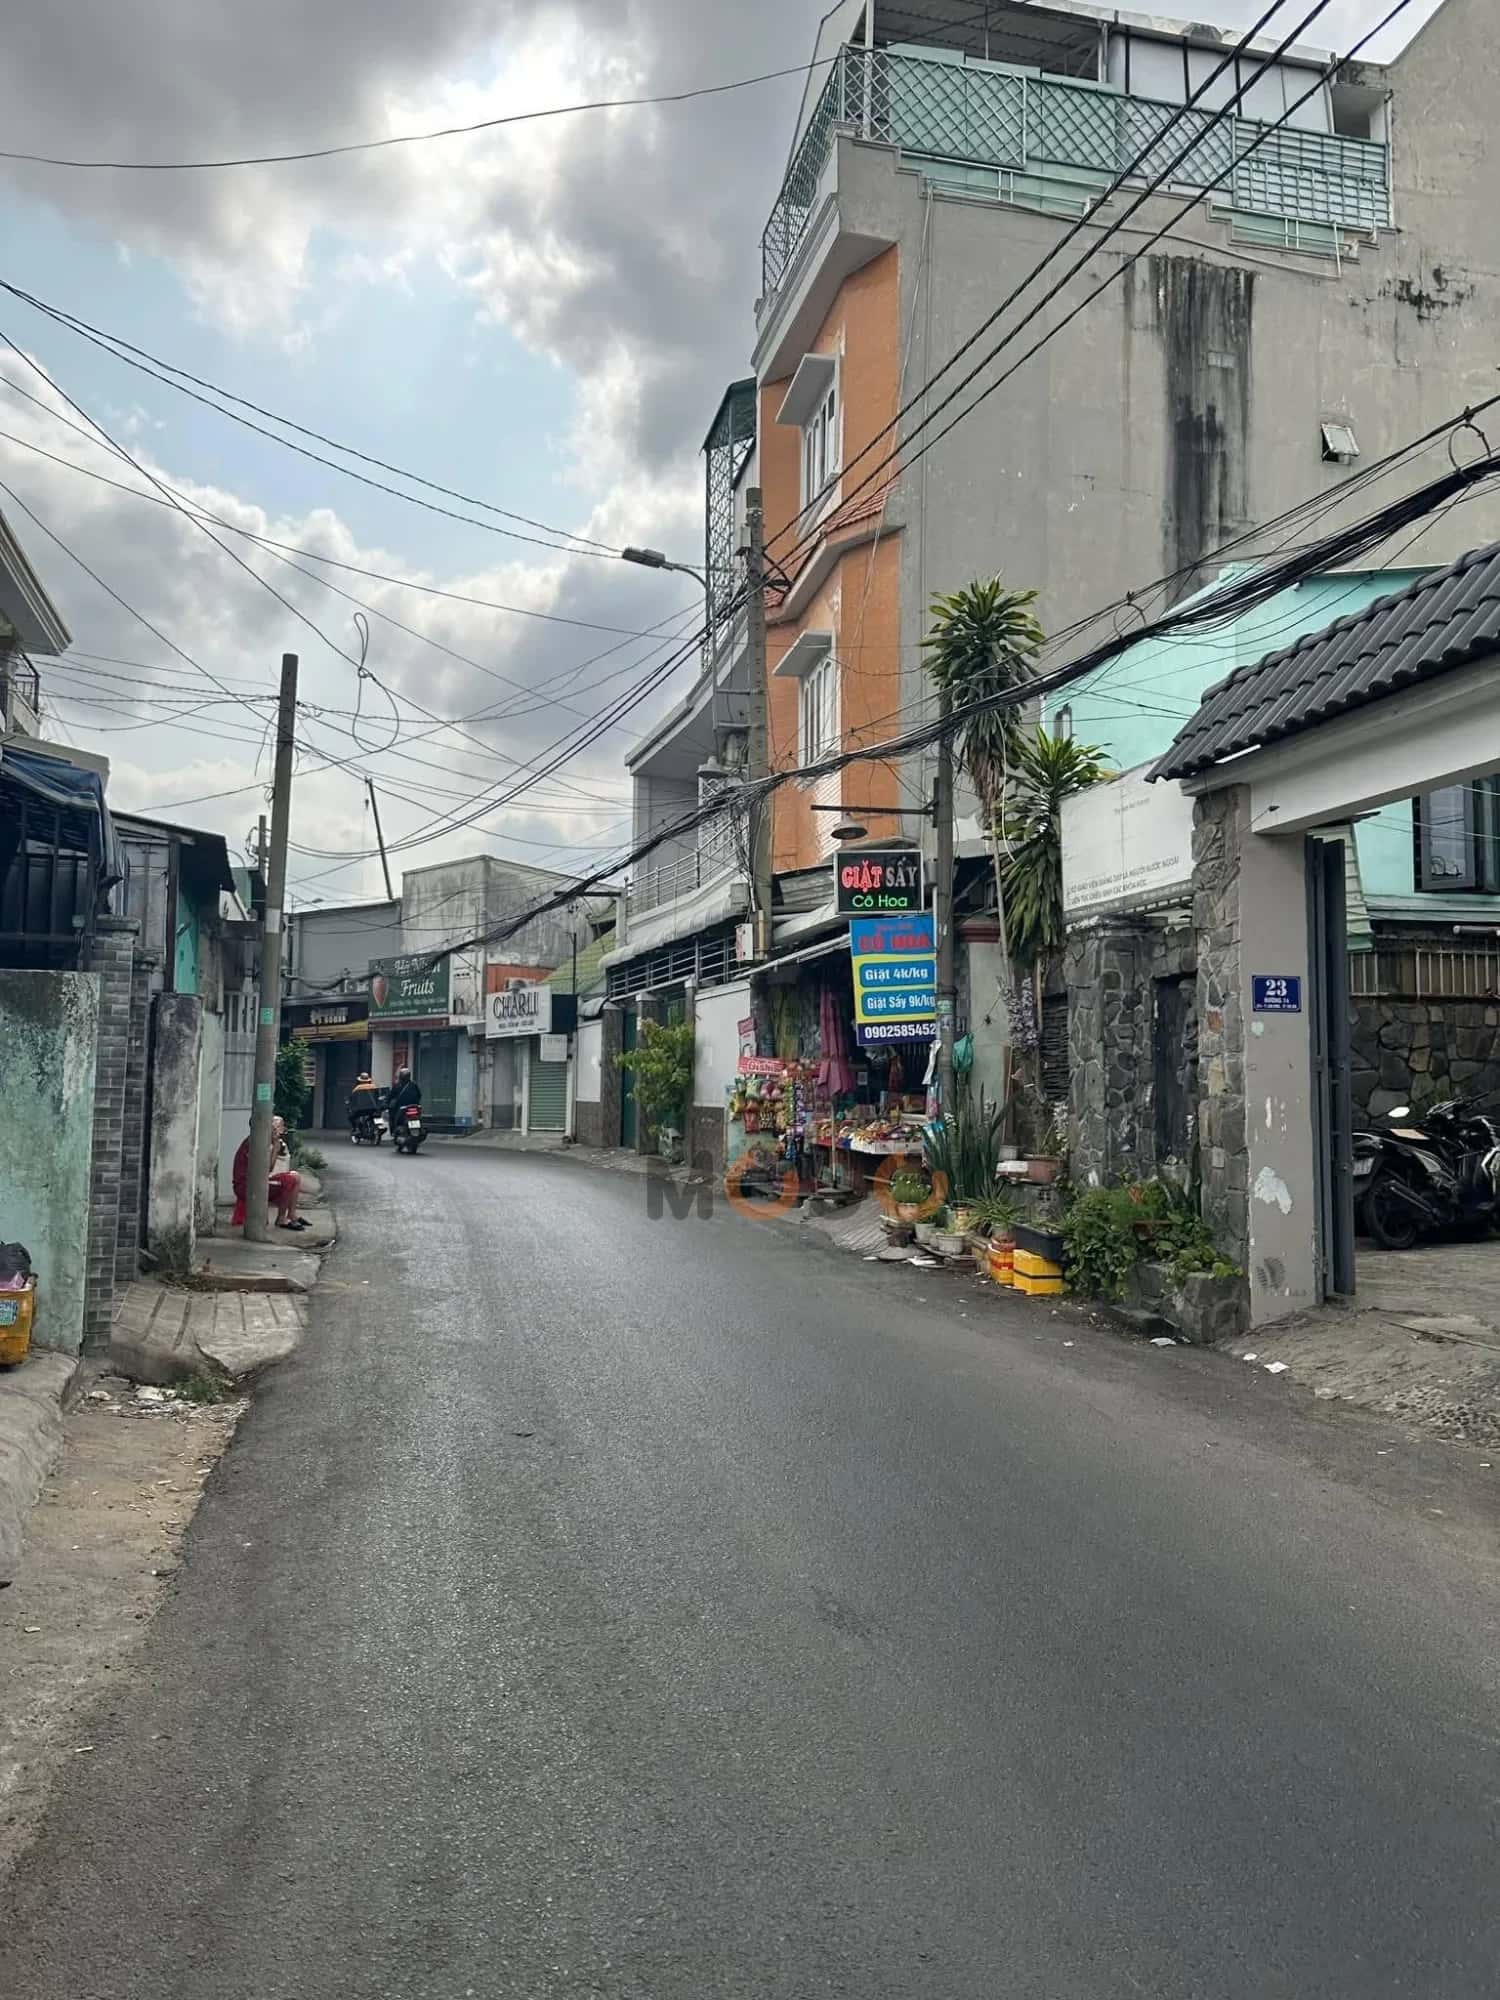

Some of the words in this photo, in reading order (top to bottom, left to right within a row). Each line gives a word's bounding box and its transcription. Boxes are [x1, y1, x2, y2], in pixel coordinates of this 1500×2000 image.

[841, 860, 883, 893] GIẶT
[886, 856, 918, 888] SẤY
[852, 895, 874, 908] Cô
[878, 894, 908, 908] Hoa
[865, 968, 890, 982] Giặt
[893, 967, 929, 979] 4k/kg
[400, 979, 435, 998] Fruits
[1266, 979, 1287, 996] 23
[867, 997, 887, 1011] Giặt
[889, 993, 907, 1009] Sấy
[909, 993, 936, 1008] 9k/kg
[864, 1023, 937, 1039] 0902585452
